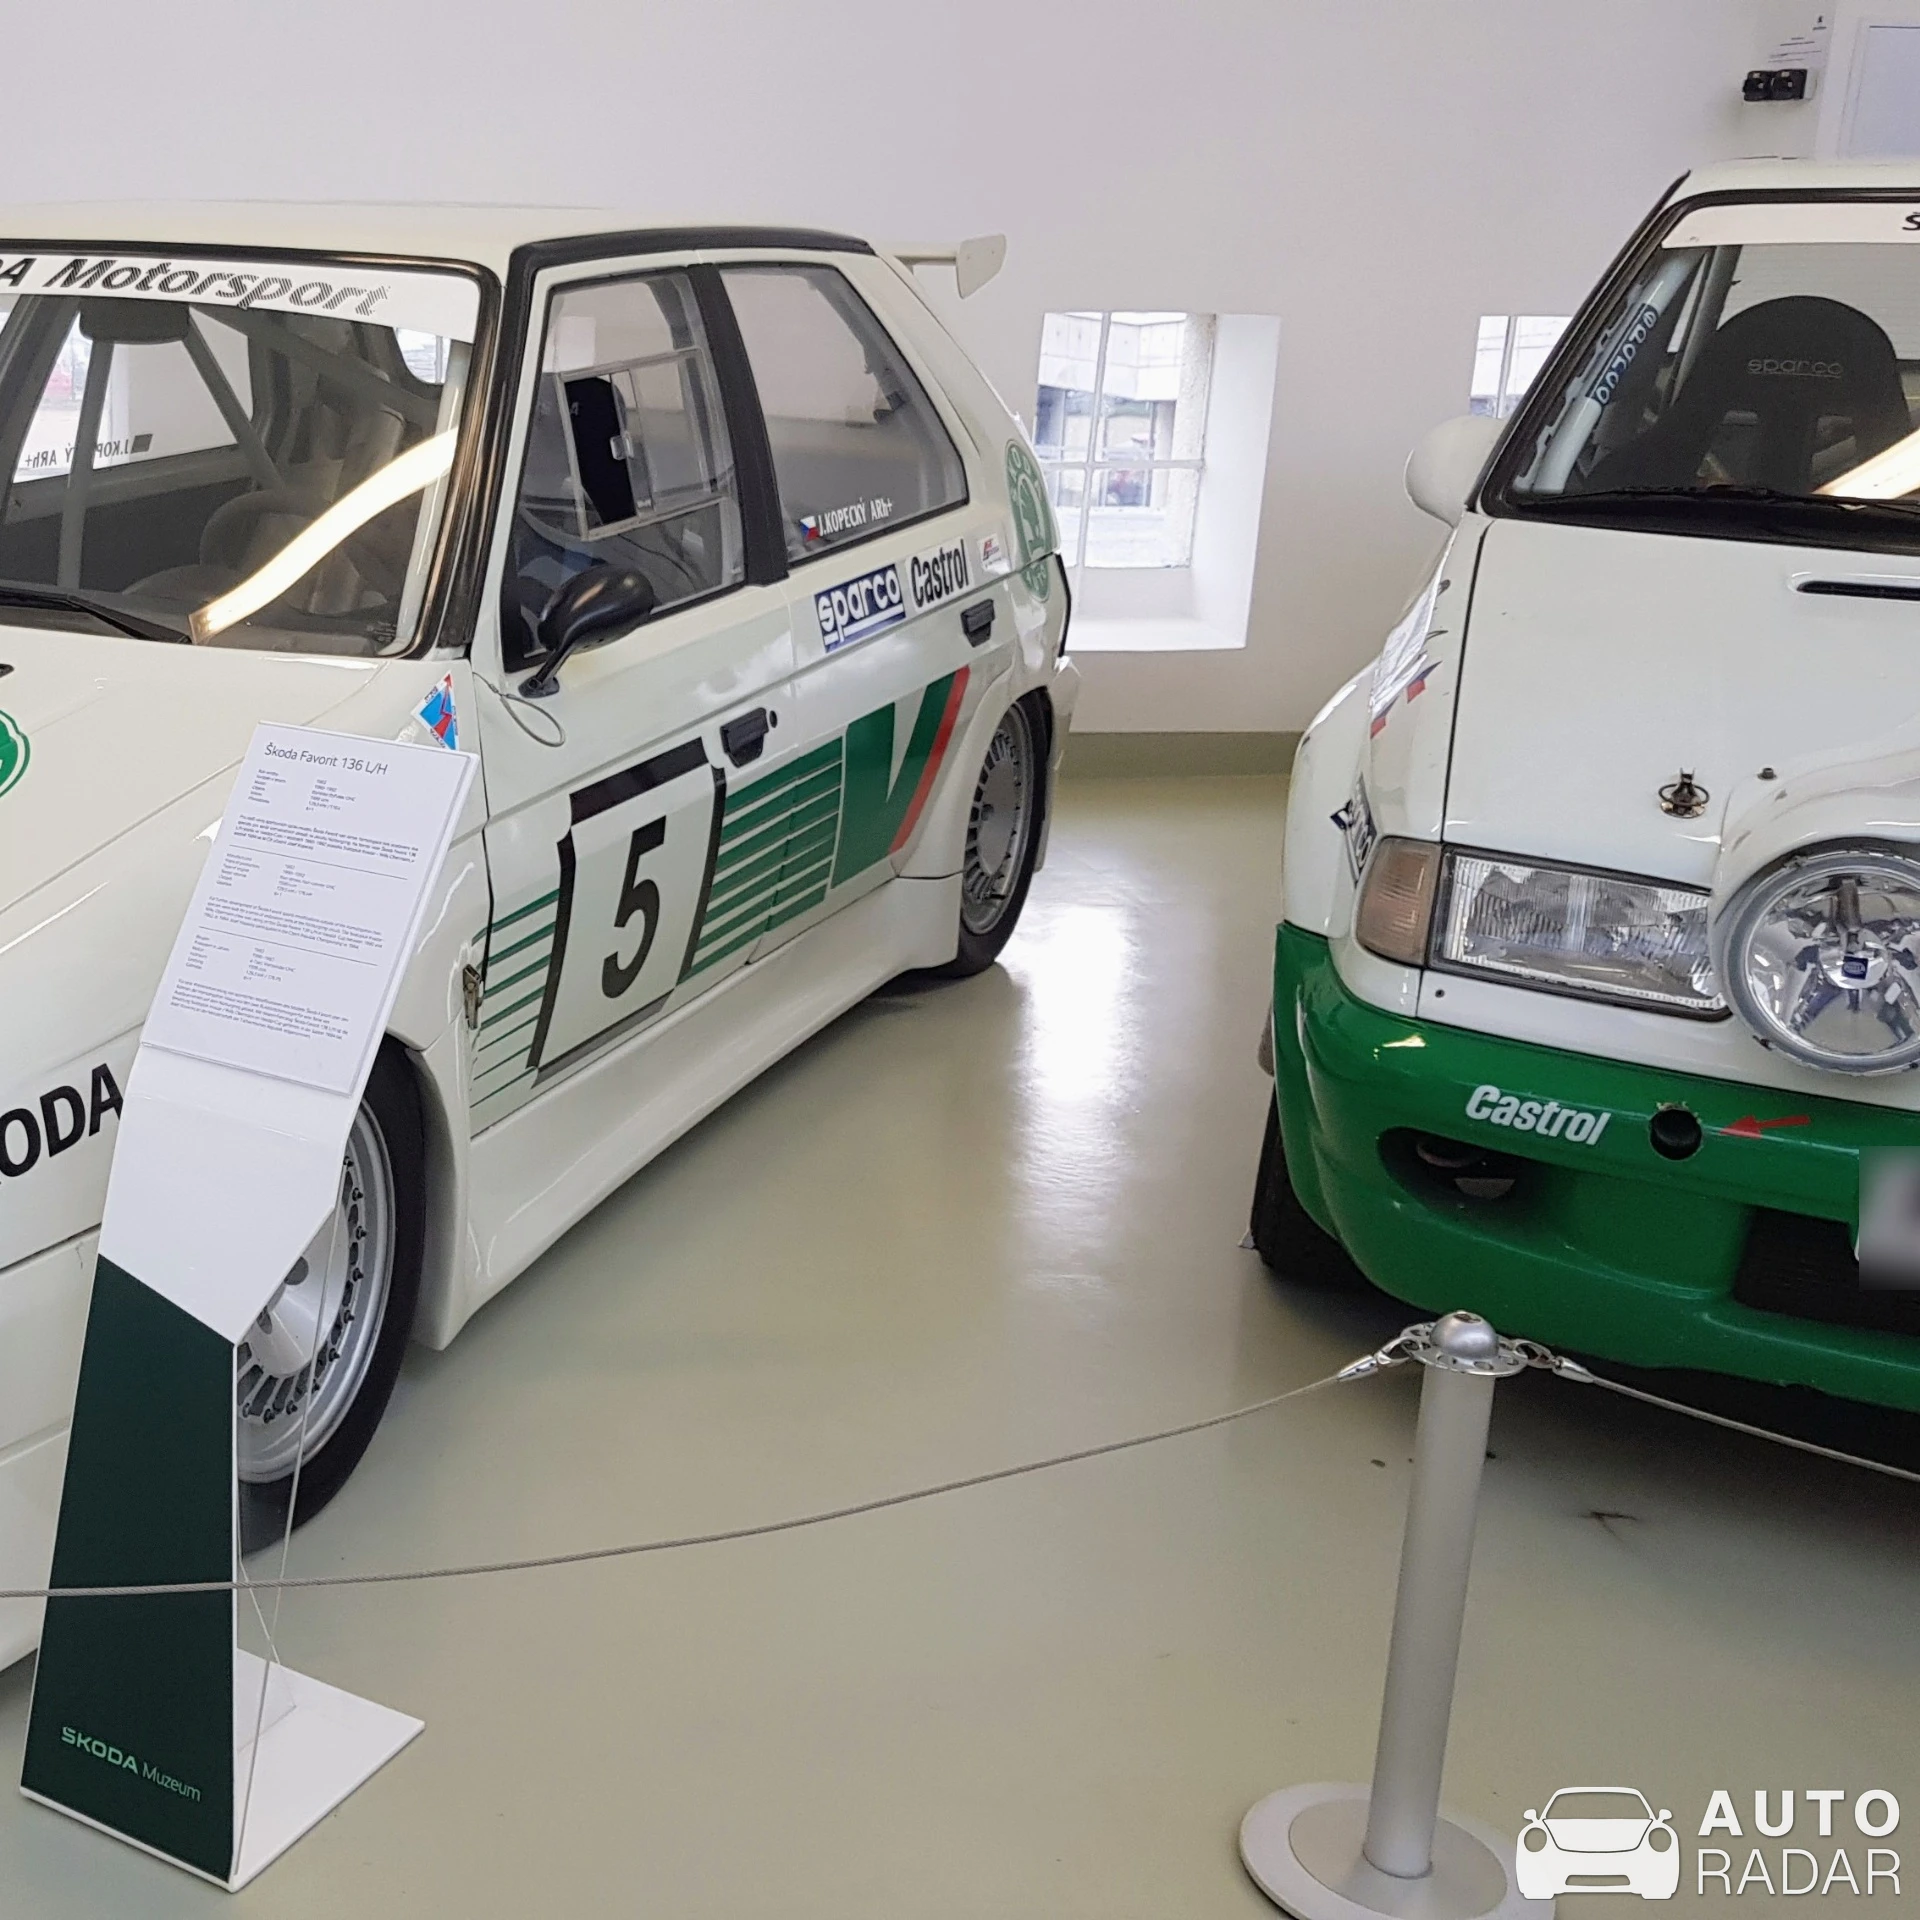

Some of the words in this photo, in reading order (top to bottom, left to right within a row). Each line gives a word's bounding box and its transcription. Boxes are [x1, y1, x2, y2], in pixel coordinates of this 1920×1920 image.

[0, 257, 38, 287] A
[42, 258, 391, 316] Motorsport
[1748, 358, 1844, 377] sparco
[818, 497, 868, 537] J.KOPECKÝ
[870, 498, 893, 522] ARh+
[818, 569, 901, 643] sparco
[911, 537, 970, 608] Castrol
[264, 742, 298, 761] Škoda
[299, 750, 339, 768] Favorit
[341, 757, 363, 771] 136
[365, 762, 388, 776] L/H
[602, 815, 667, 1000] 5
[1465, 1084, 1611, 1147] Castrol
[142, 1761, 202, 1803] Muzeum
